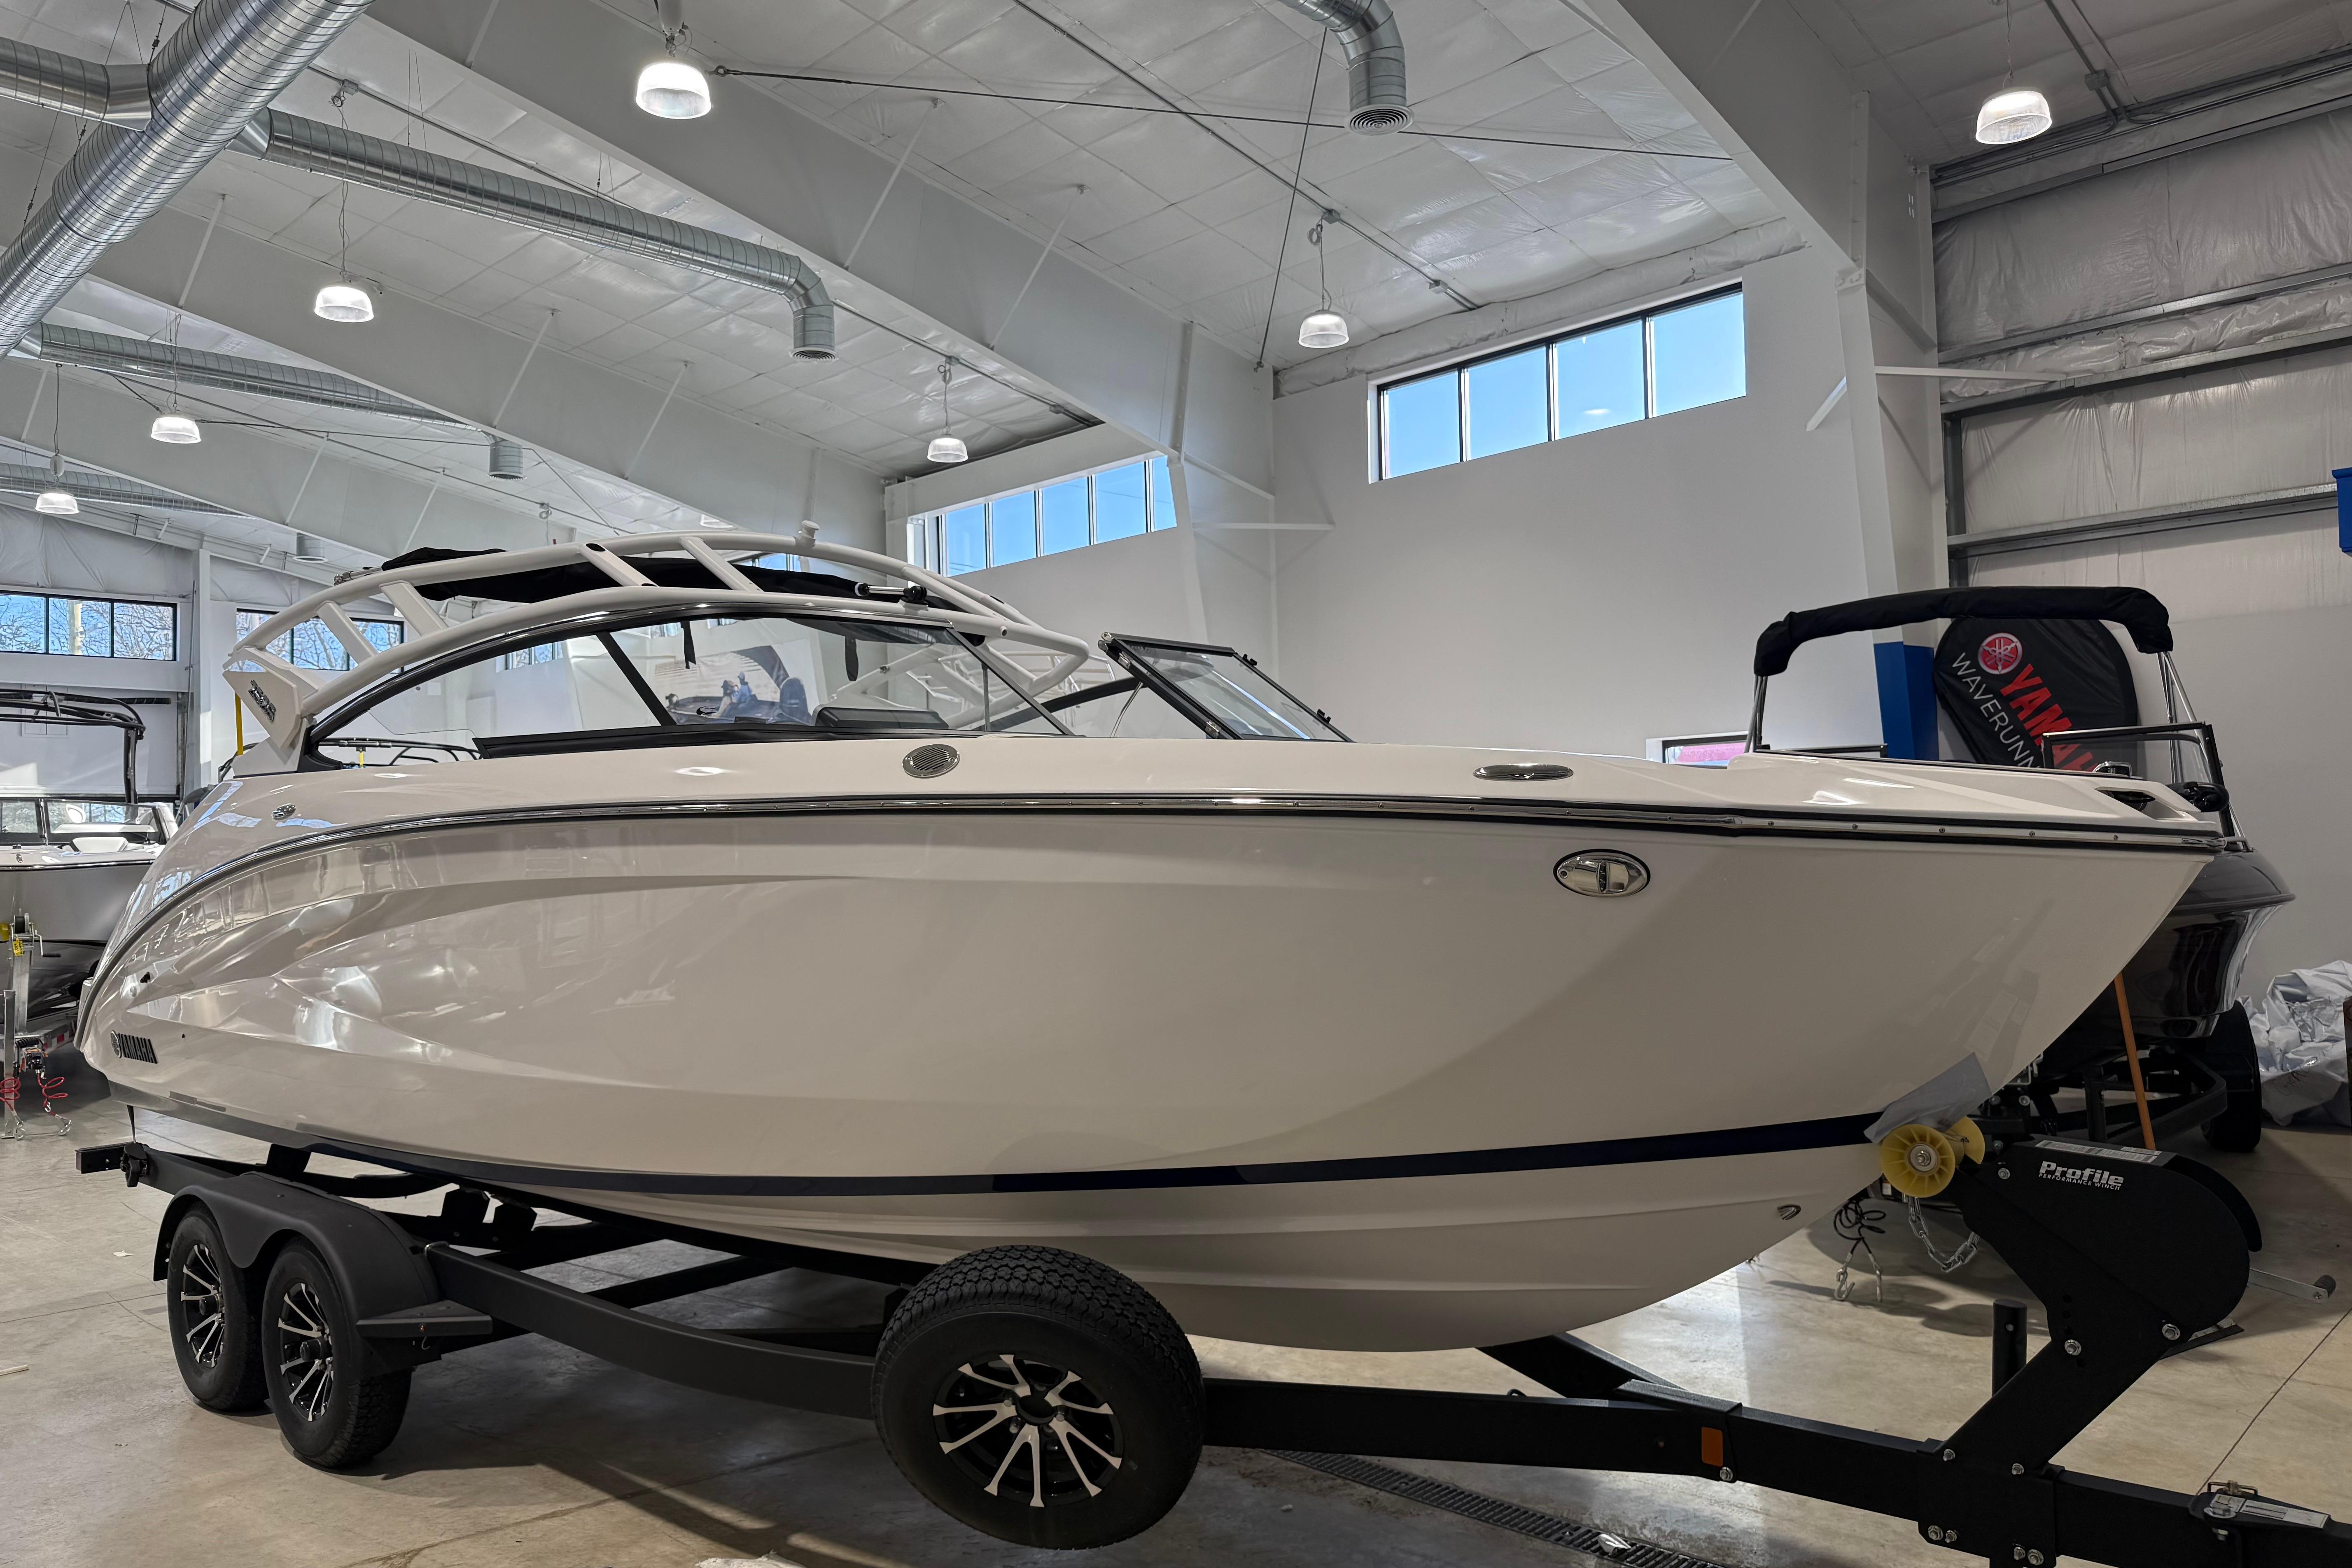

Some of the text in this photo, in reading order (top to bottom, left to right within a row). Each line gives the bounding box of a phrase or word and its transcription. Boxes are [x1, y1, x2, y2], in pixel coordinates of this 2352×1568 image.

[117, 1033, 158, 1064] YAMAHA
[2039, 1160, 2124, 1187] Profile
[2039, 1173, 2121, 1190] PERFORMANCE WINCH
